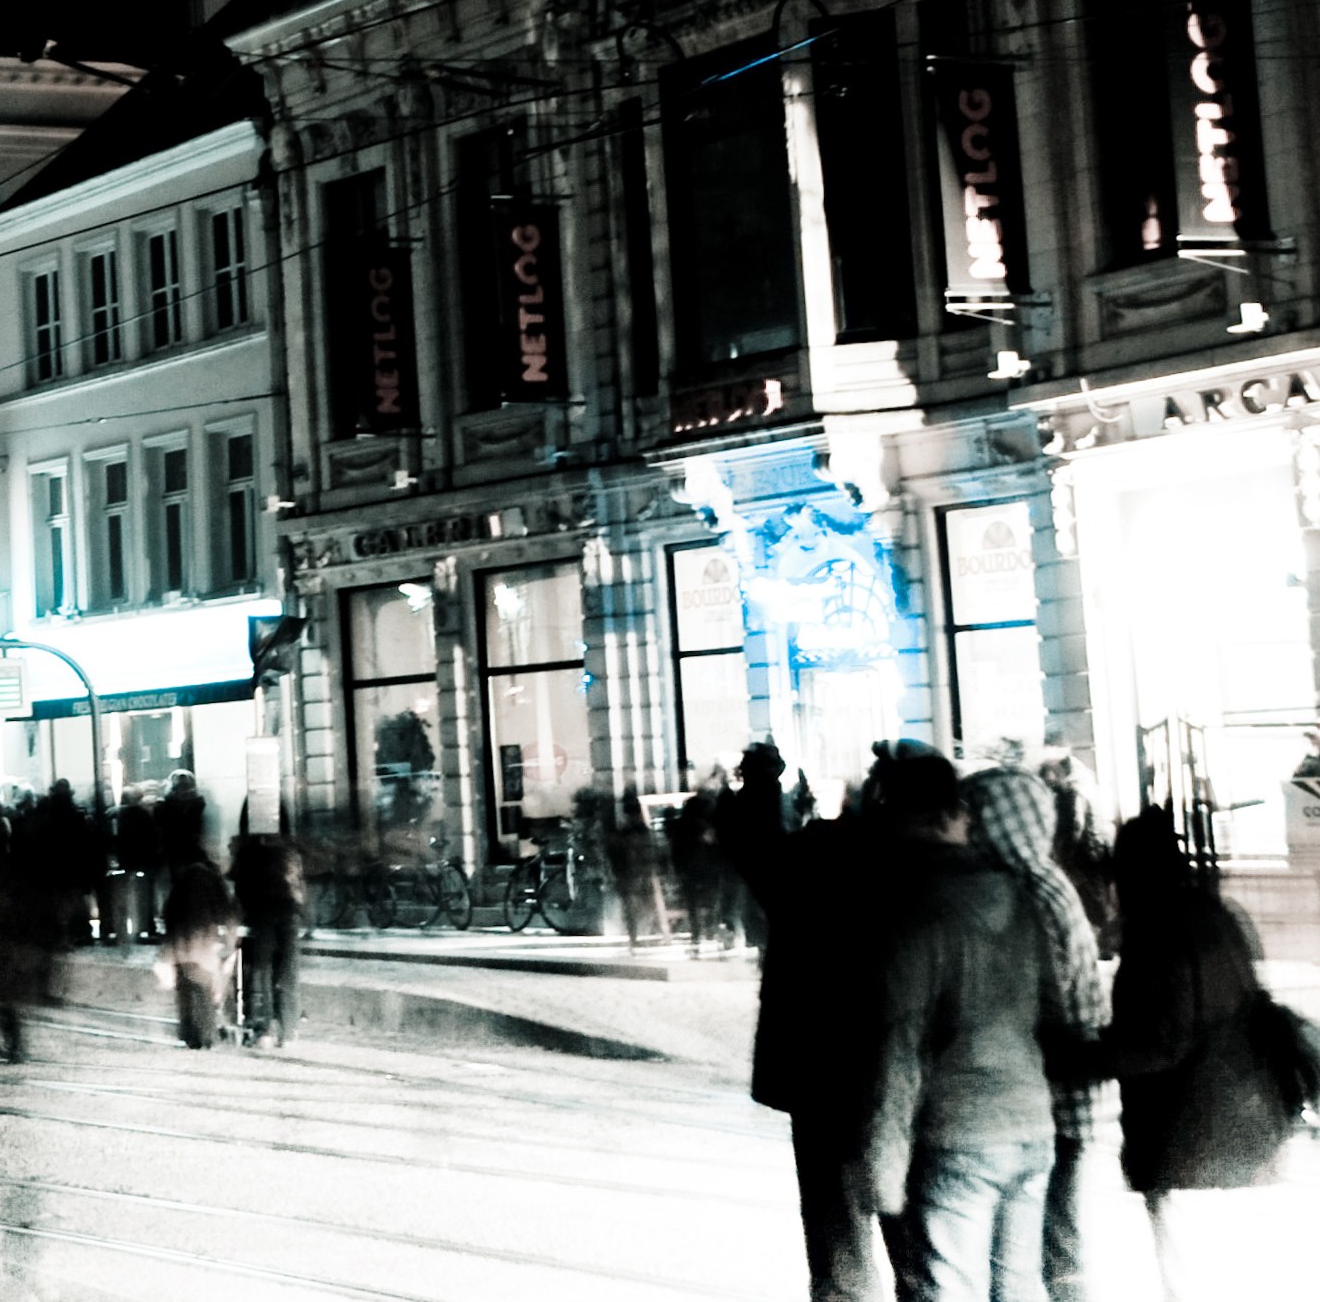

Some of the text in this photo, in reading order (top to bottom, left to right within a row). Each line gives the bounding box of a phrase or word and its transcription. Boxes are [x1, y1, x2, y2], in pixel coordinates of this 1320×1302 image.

[959, 88, 1008, 278] NETLOG
[1187, 11, 1241, 223] NETLOG
[368, 265, 402, 414] NETLOG
[511, 223, 550, 382] NETLOG
